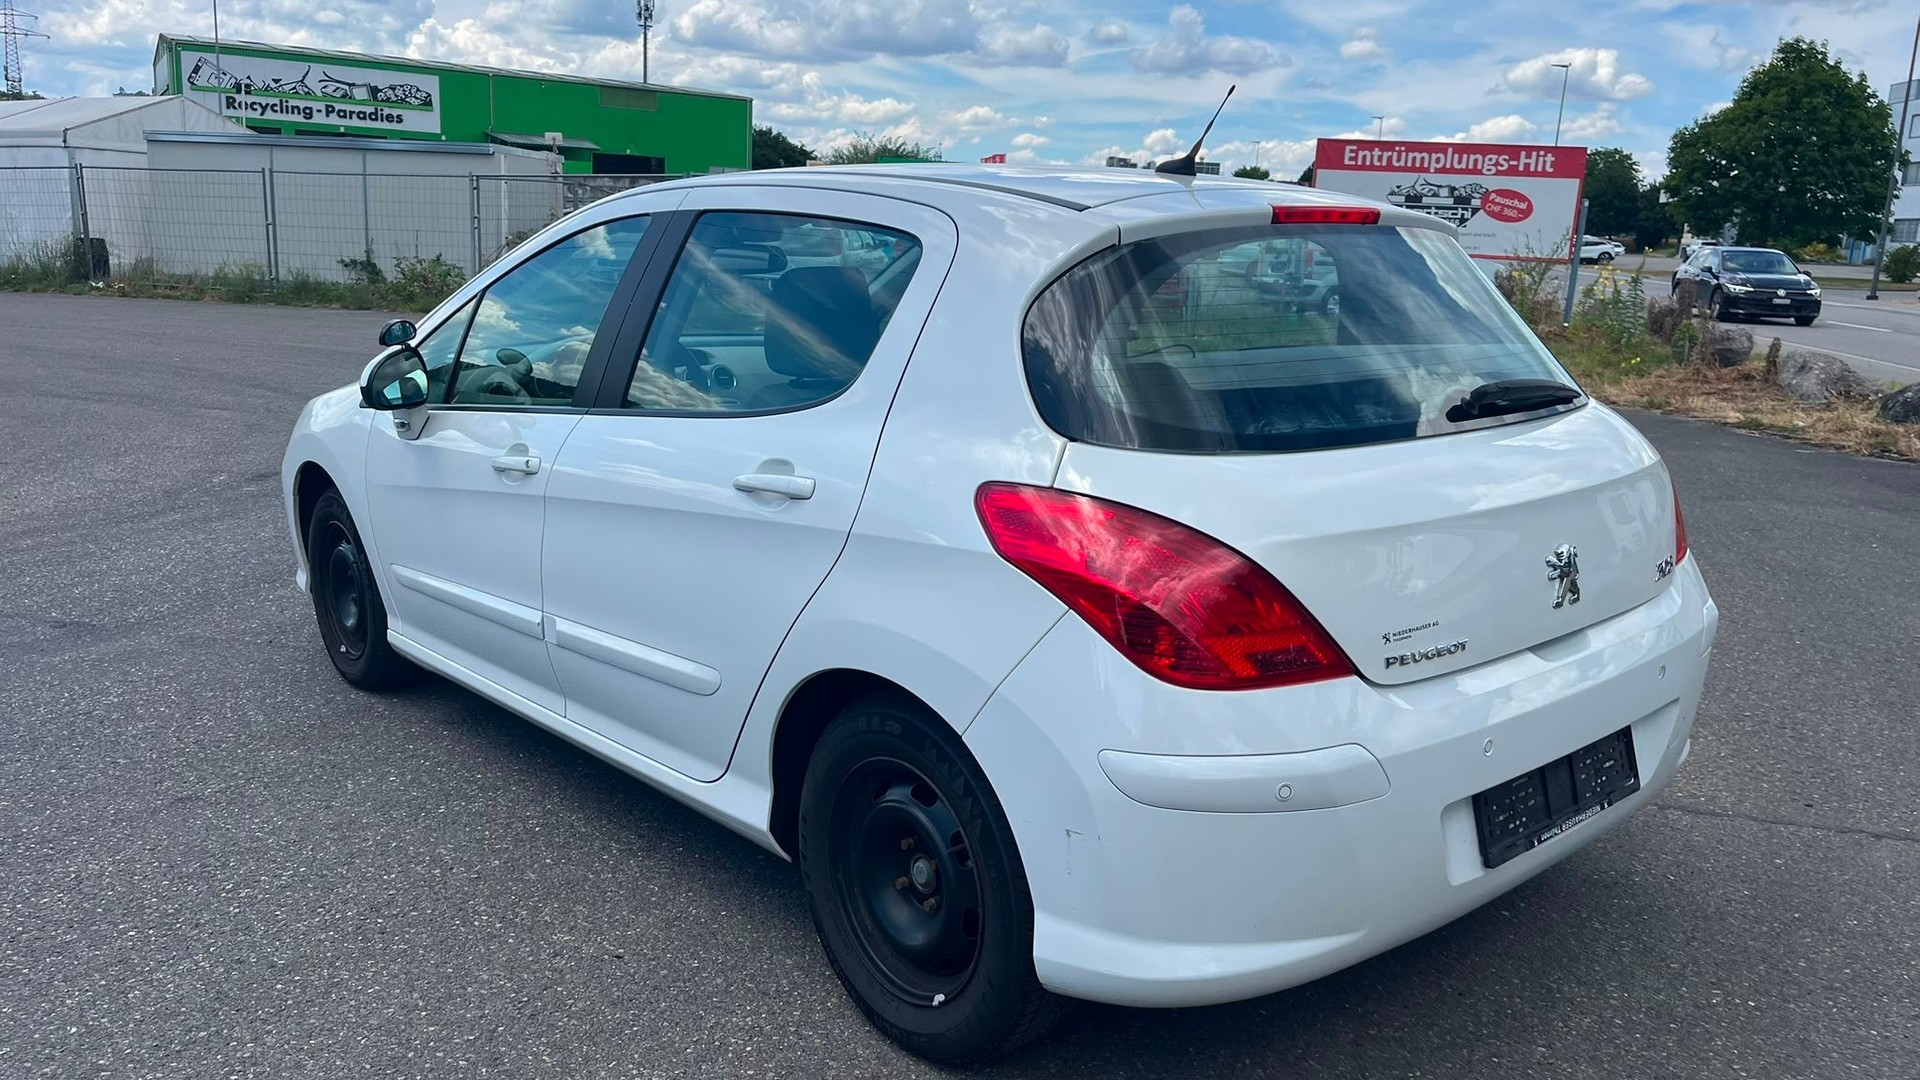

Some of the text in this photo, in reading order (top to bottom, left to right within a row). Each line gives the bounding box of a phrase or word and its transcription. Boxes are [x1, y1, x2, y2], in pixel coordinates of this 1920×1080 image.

[225, 96, 404, 124] Recycling-Paradies
[1343, 145, 1555, 174] Entrümplungs-Hit
[1485, 203, 1502, 213] CHF
[1489, 193, 1528, 210] Pauschal
[1392, 622, 1431, 638] NIEDERHAUSER
[1384, 638, 1469, 670] PEUGEOT
